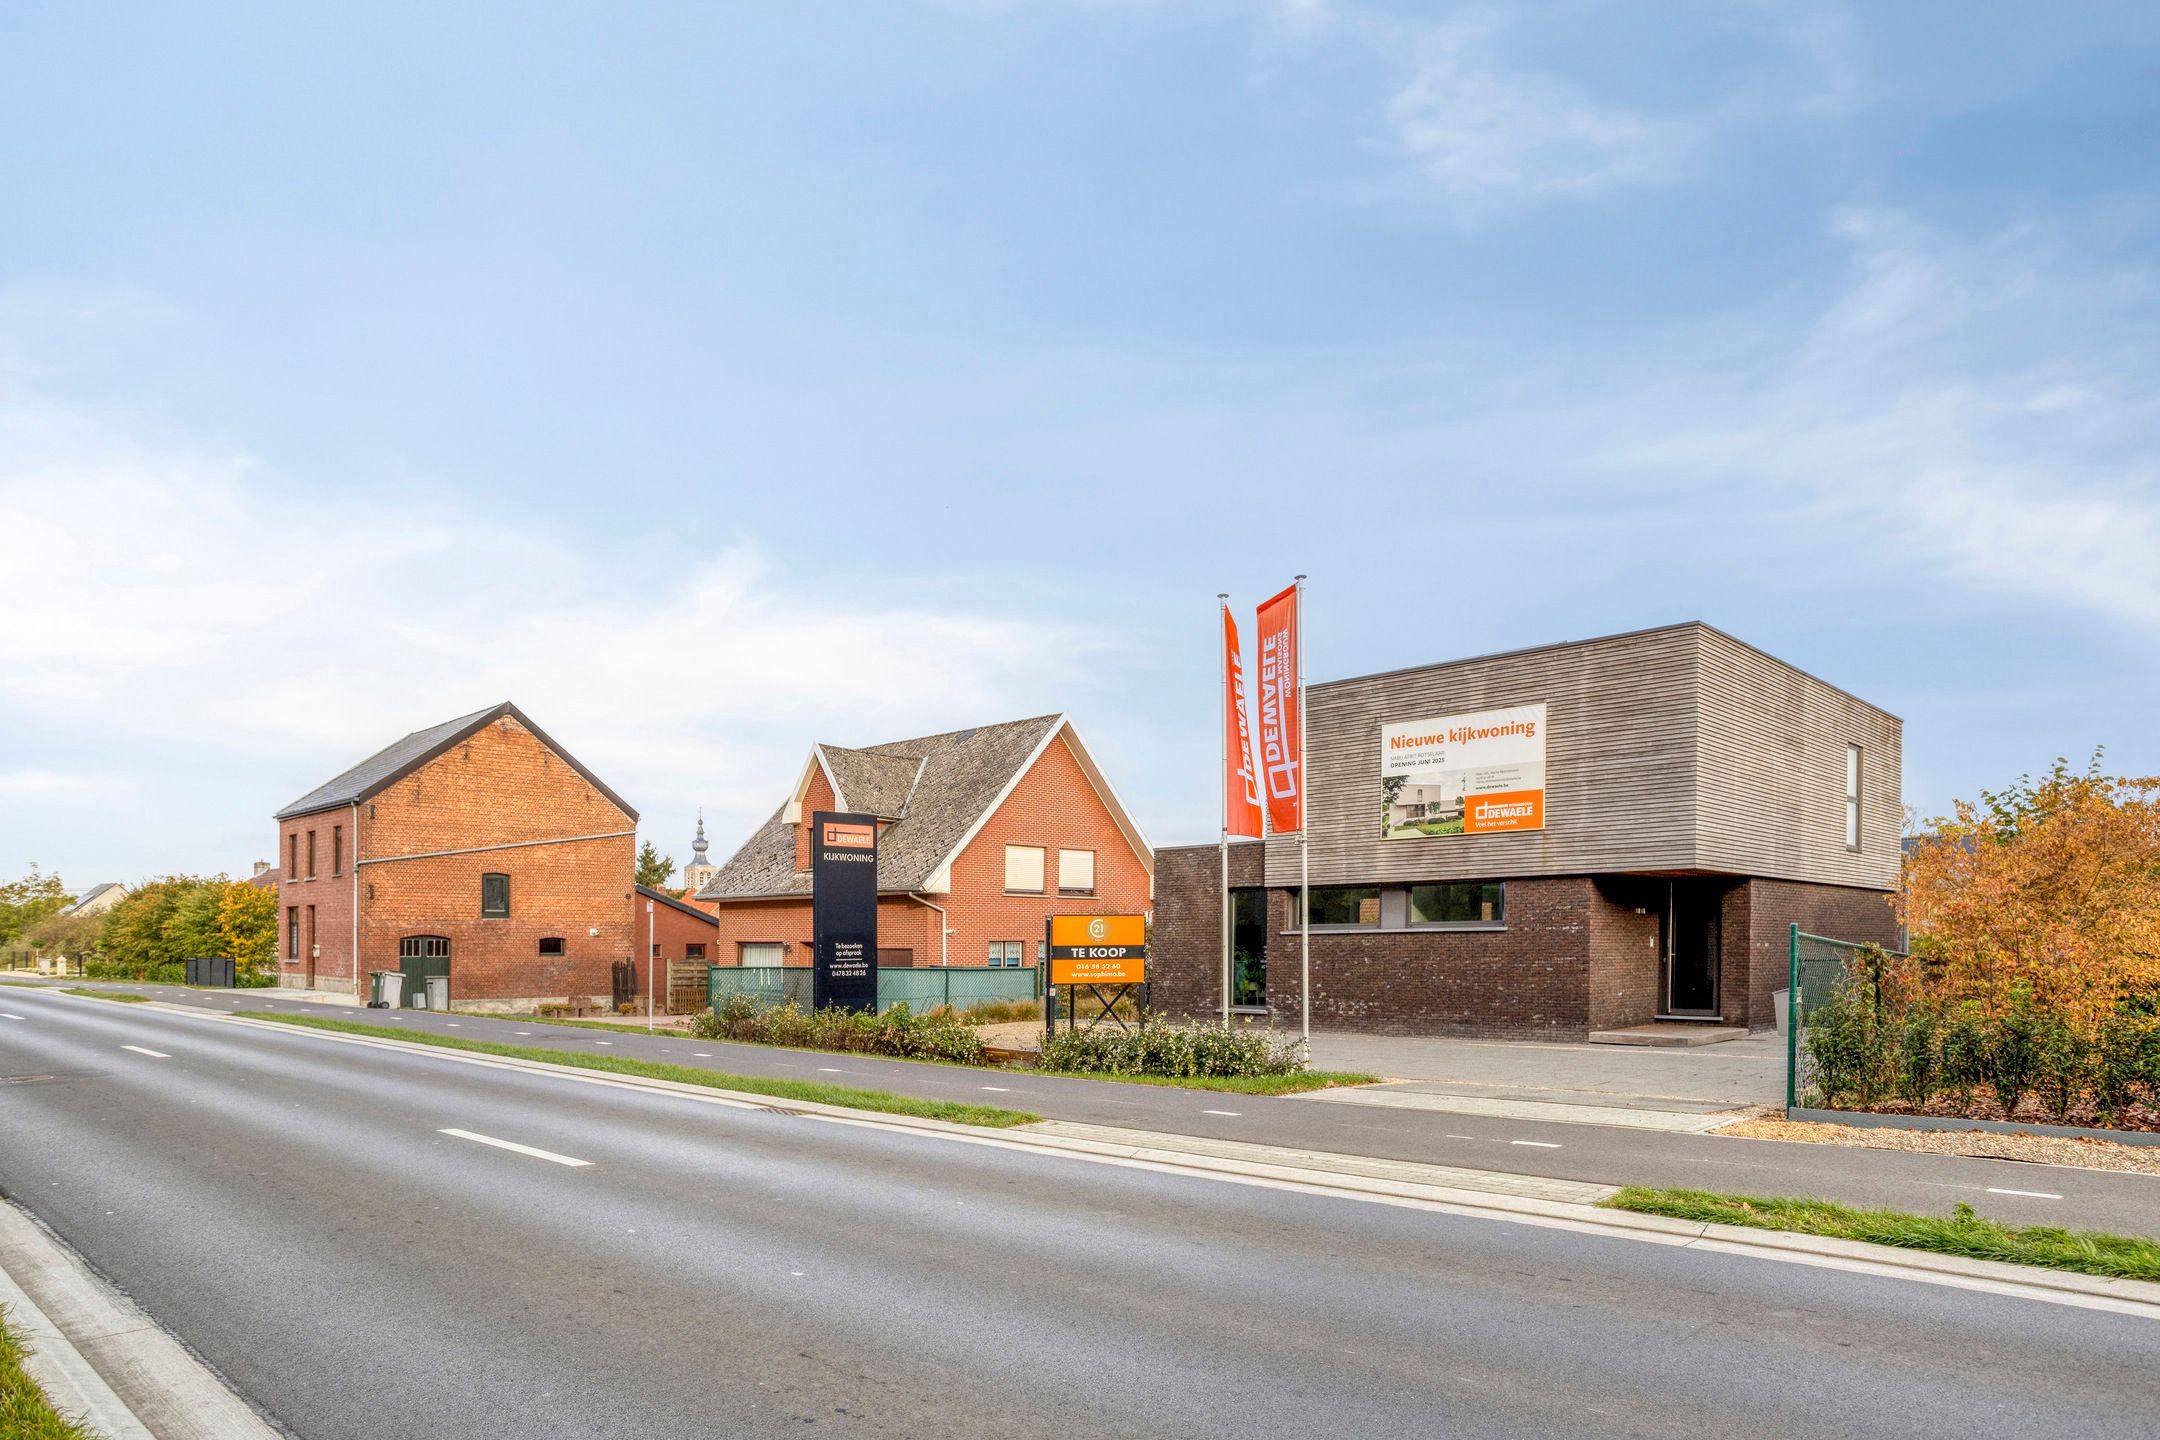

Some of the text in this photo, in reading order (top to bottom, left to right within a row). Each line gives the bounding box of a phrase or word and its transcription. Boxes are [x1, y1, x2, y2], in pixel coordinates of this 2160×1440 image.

[1390, 720, 1536, 749] Nieuwe kijkwoning
[1390, 760, 1416, 768] OPENING
[1488, 805, 1533, 819] DEWAELE
[837, 835, 871, 844] DEWAELE
[823, 852, 874, 862] KIJKWONING
[1071, 947, 1127, 958] TE KOOP
